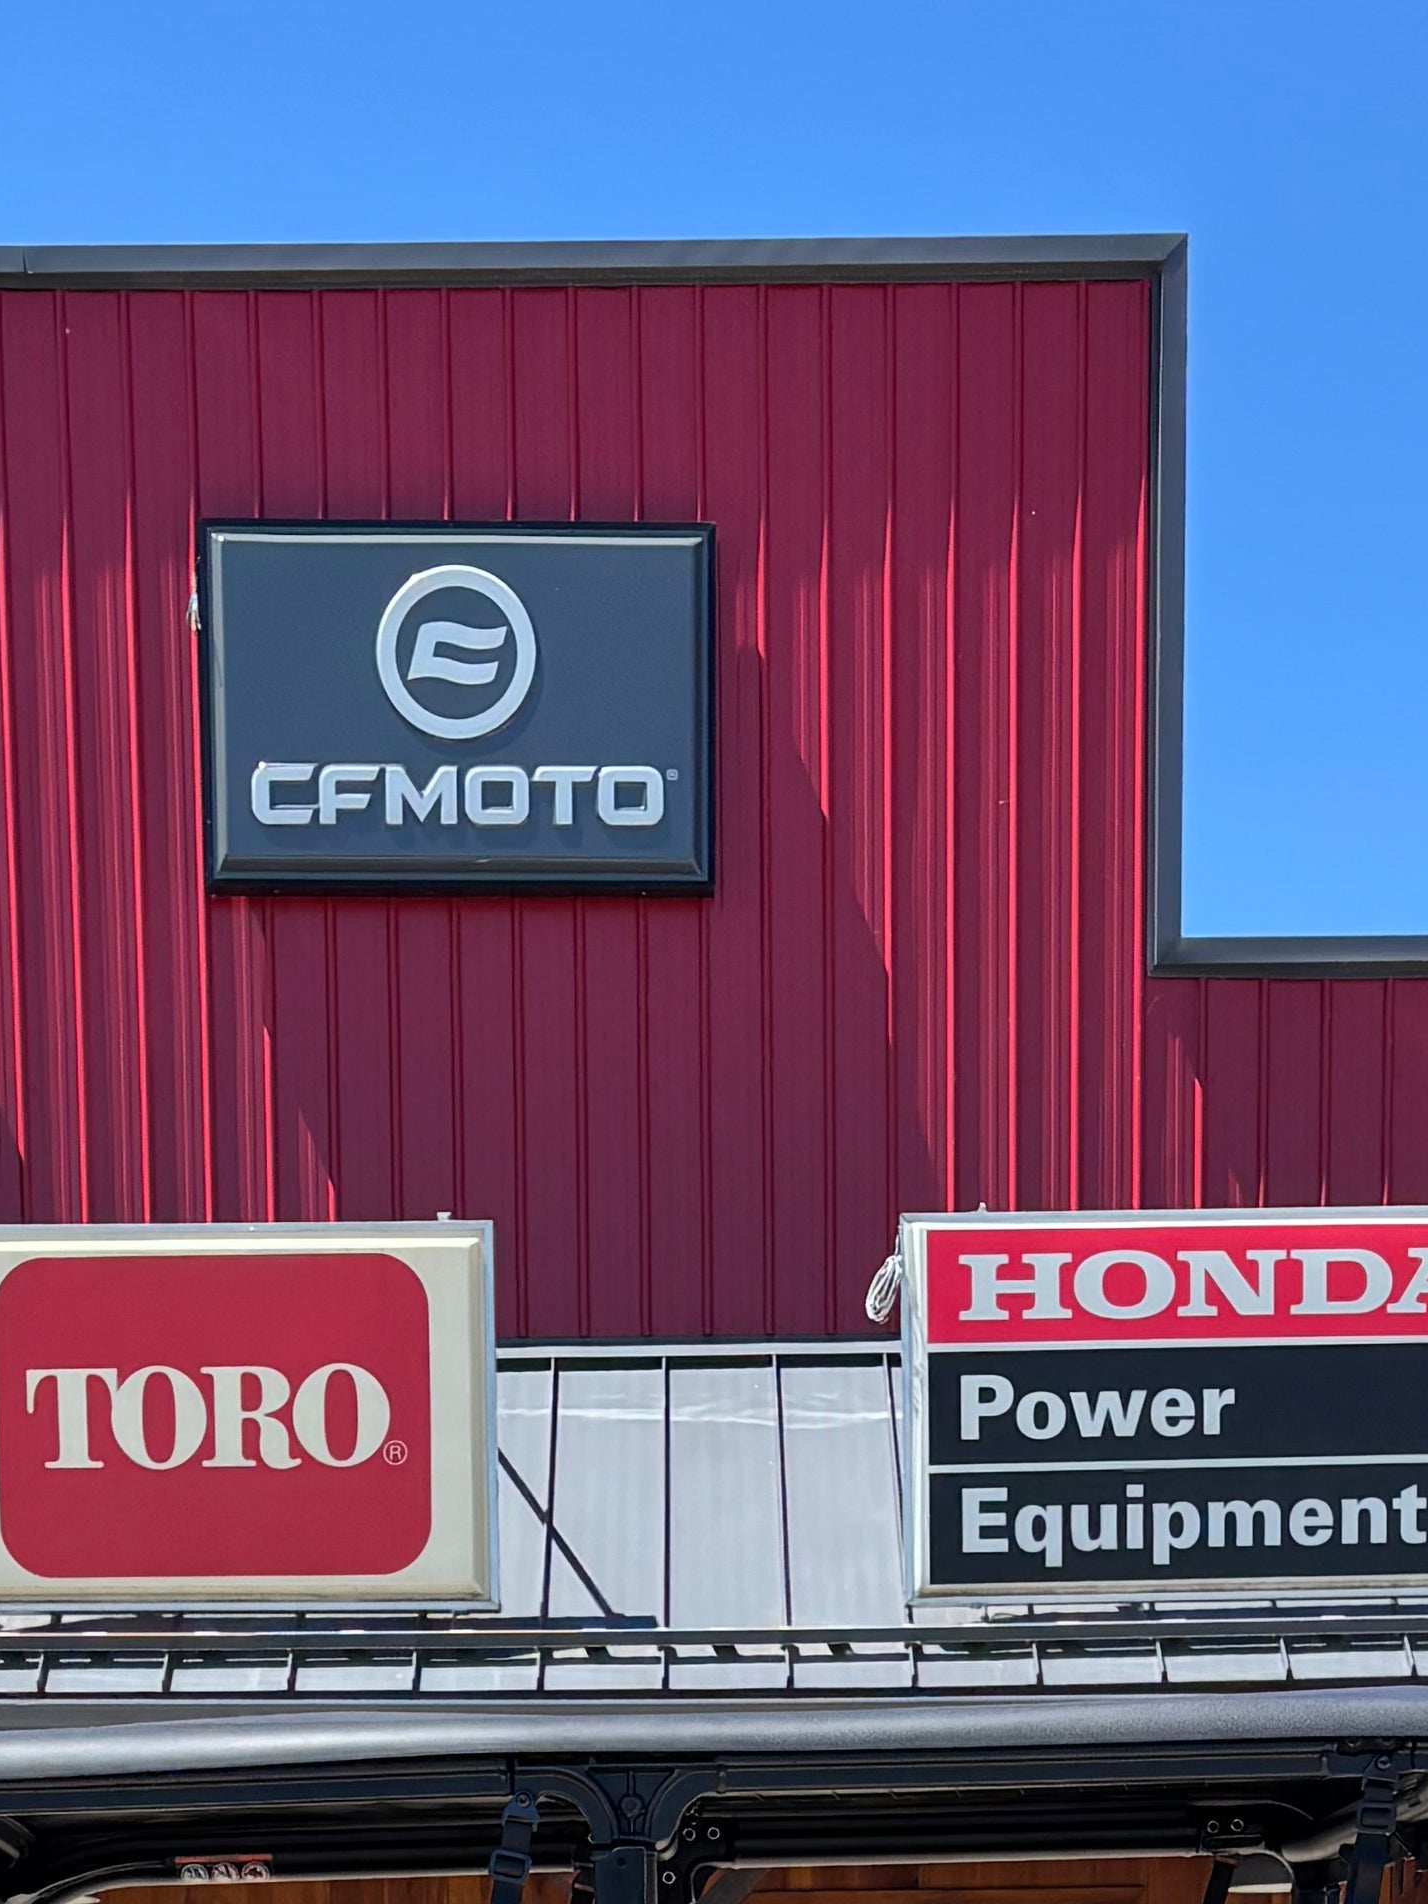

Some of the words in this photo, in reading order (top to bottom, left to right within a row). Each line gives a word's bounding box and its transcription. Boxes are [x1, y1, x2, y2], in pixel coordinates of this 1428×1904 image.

[251, 763, 664, 827] CFMOTO
[24, 1362, 392, 1471] TORO
[959, 1373, 1236, 1440] Power
[959, 1483, 1428, 1568] Equipment
